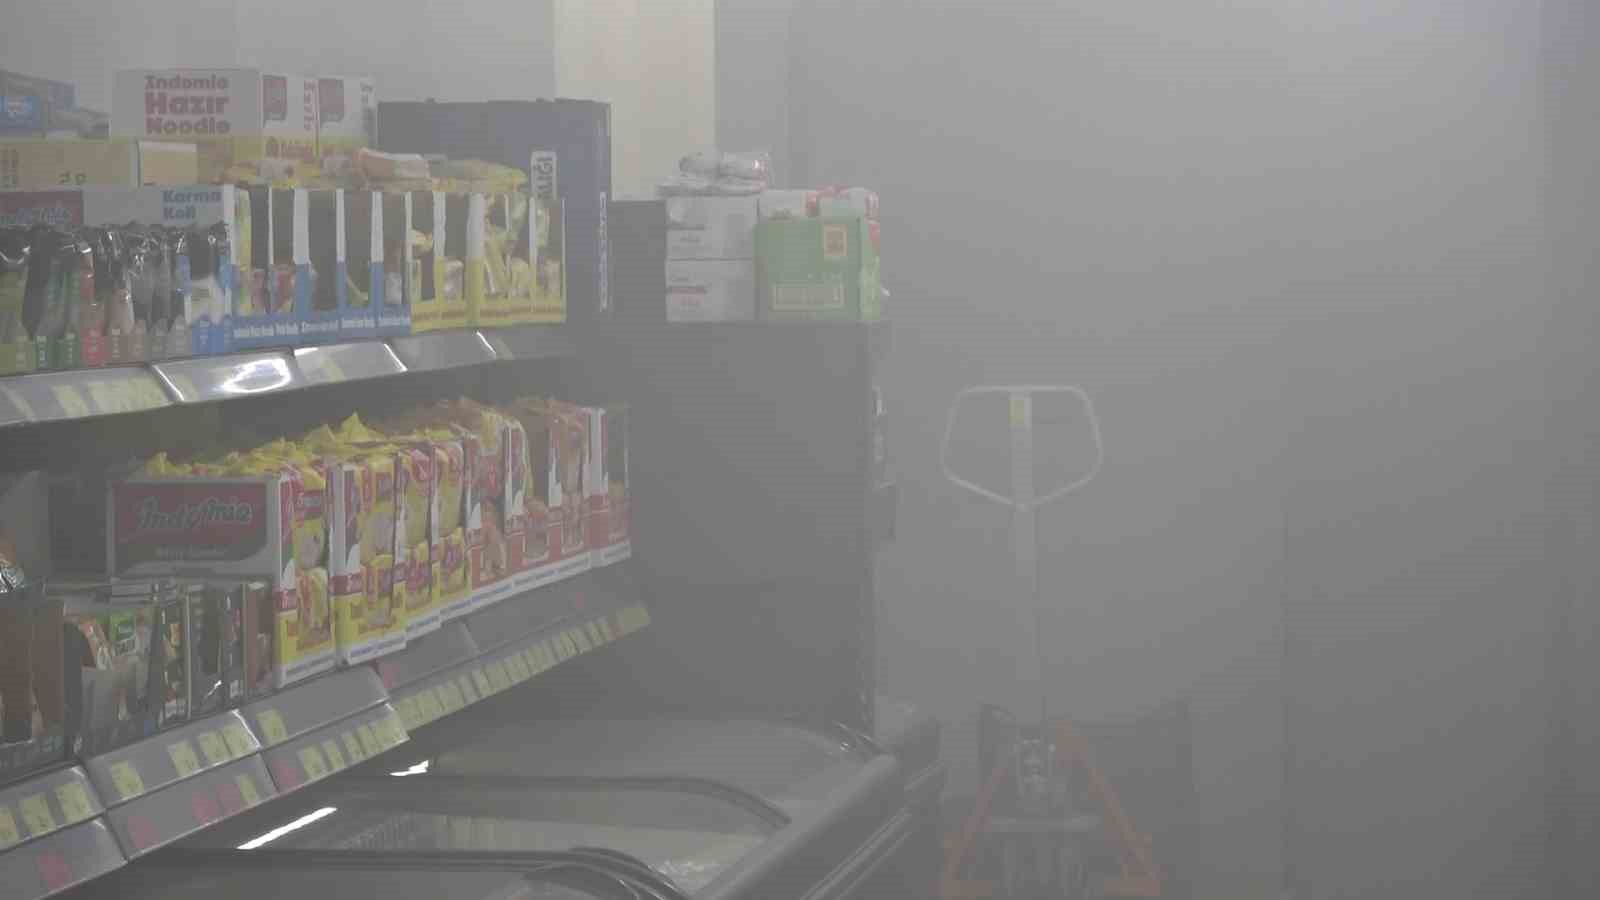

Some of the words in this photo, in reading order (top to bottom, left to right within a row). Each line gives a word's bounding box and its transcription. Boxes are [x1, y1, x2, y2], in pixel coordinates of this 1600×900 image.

[144, 91, 230, 116] Hazır
[144, 117, 231, 135] Noodle
[163, 189, 221, 203] Karma
